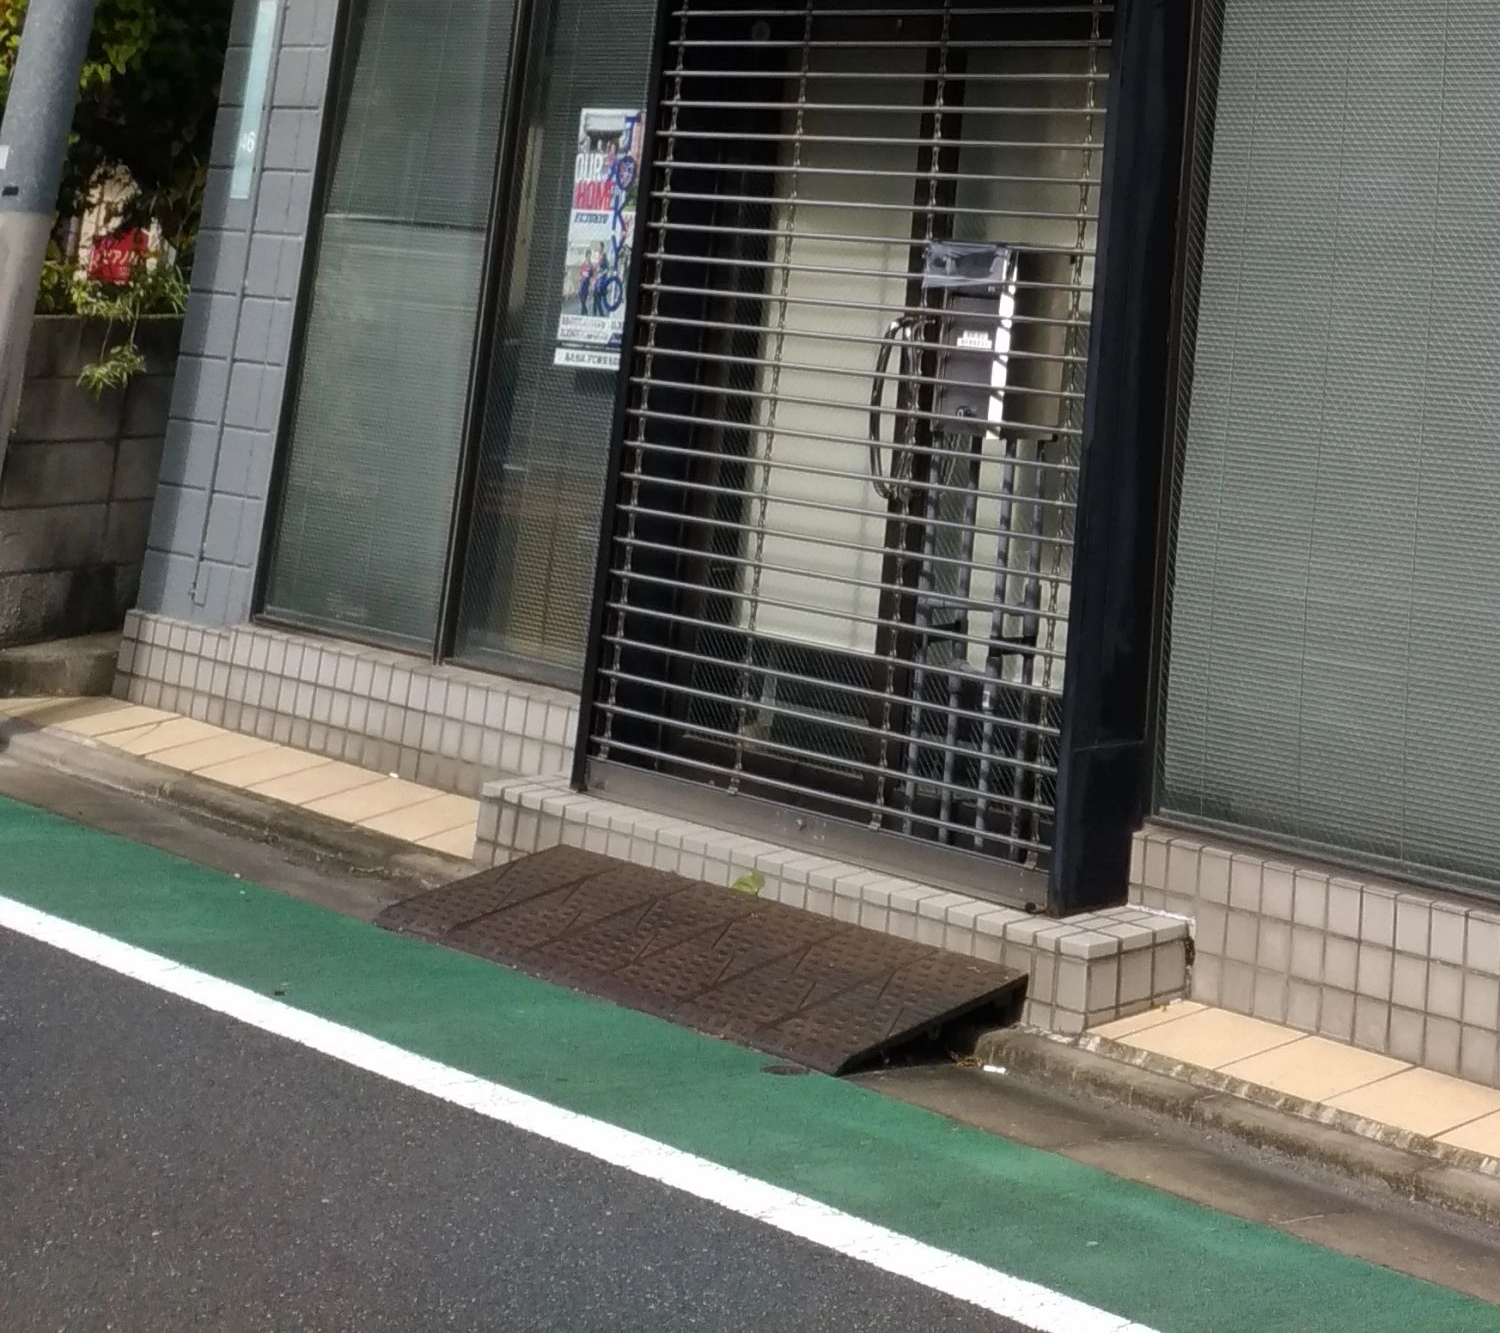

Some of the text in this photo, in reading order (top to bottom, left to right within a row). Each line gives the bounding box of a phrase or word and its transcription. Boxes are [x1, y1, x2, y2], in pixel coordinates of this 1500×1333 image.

[575, 153, 604, 182] OUR
[573, 181, 615, 210] HOME
[600, 116, 641, 312] TOKYO
